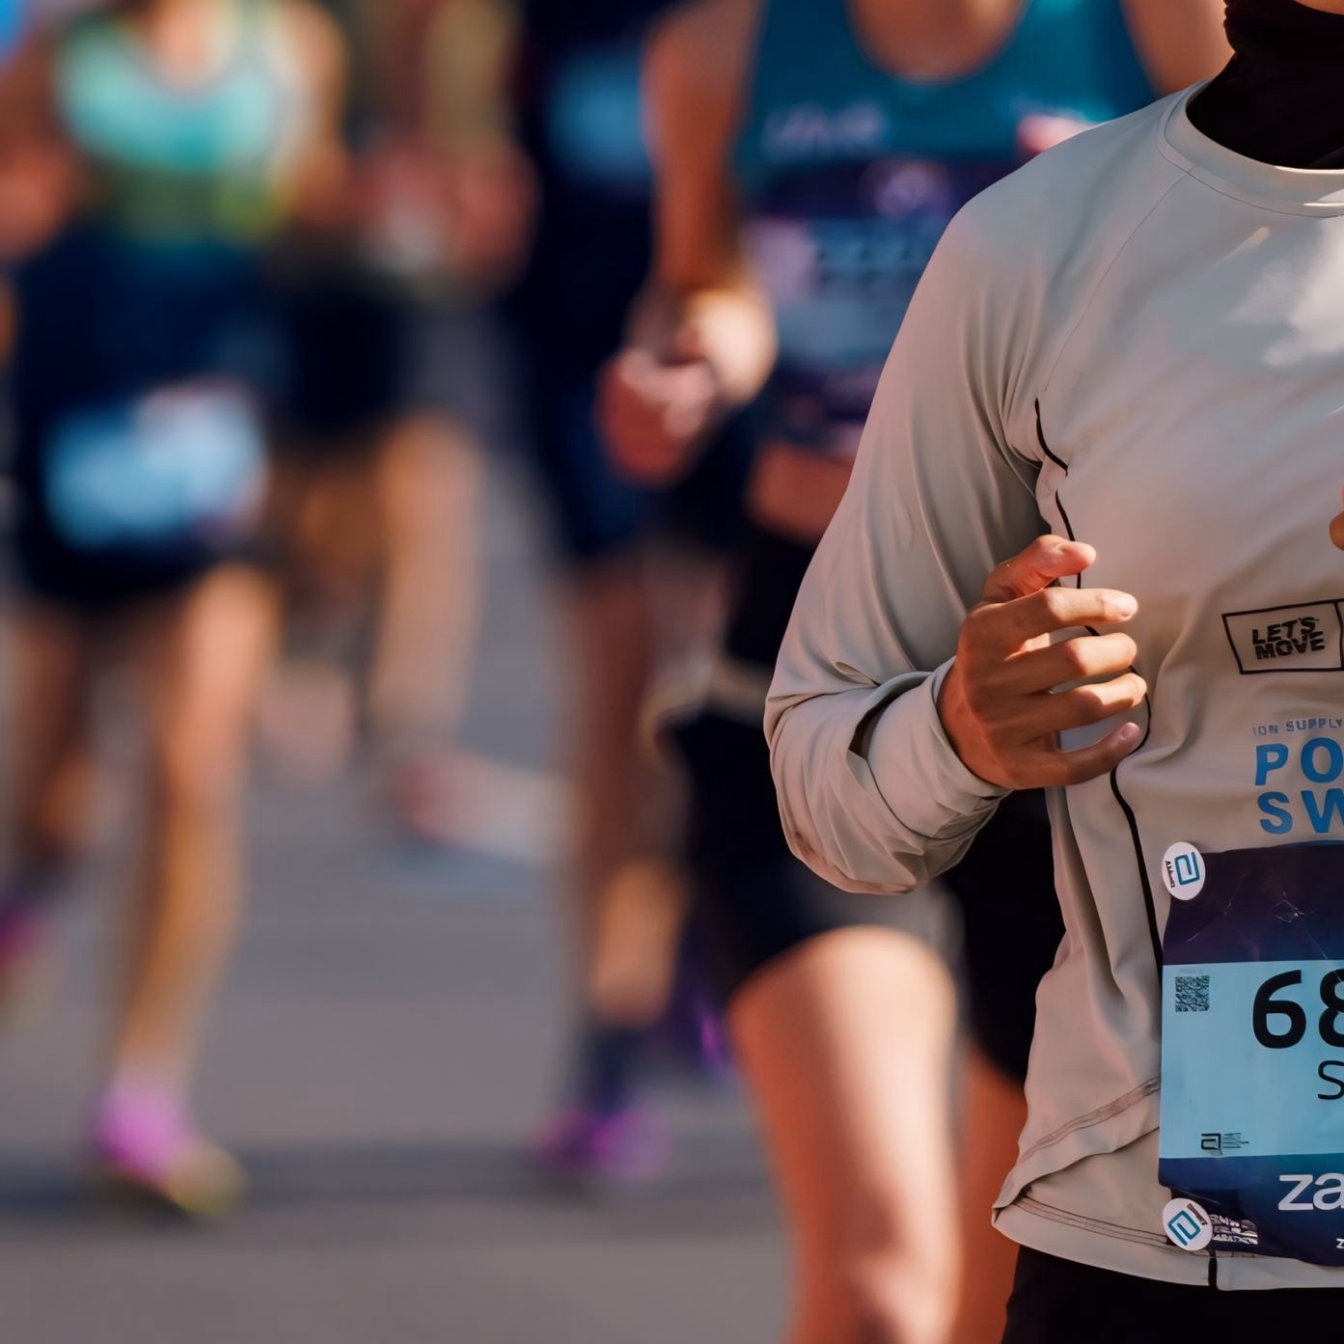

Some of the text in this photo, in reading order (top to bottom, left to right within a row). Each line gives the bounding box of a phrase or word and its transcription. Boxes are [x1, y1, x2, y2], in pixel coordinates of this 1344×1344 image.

[1252, 616, 1320, 645] LET'S
[1254, 631, 1325, 660] MOVE
[1286, 718, 1342, 732] SUPPLY
